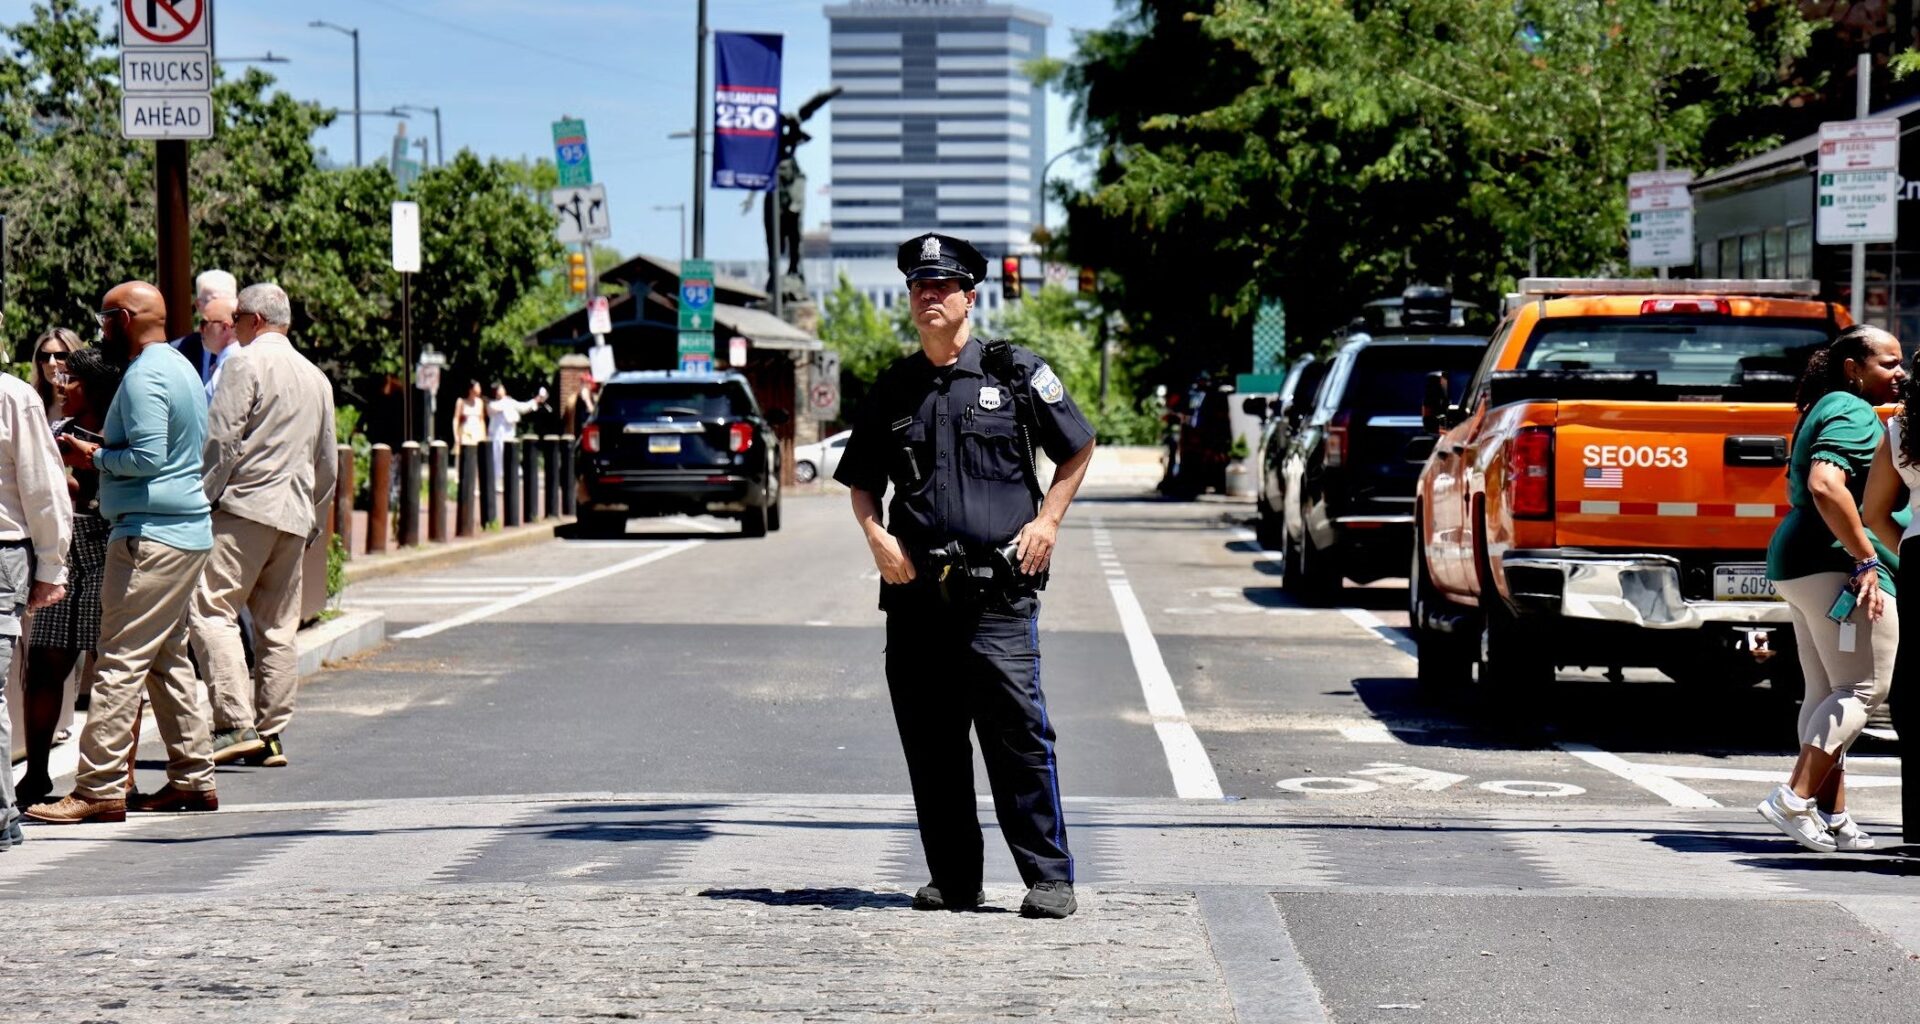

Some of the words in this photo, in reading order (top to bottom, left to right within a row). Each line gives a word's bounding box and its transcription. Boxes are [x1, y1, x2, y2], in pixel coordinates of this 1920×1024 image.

[129, 61, 203, 81] TRUCKS
[716, 91, 778, 106] PHILADELPHIA
[134, 106, 201, 127] AHEAD
[716, 104, 777, 131] 250
[561, 146, 584, 163] 95
[1840, 142, 1876, 151] PARKING
[1851, 172, 1888, 182] PARKING
[1851, 194, 1887, 204] PARKING
[685, 287, 709, 304] 95
[1583, 445, 1688, 468] SE0053
